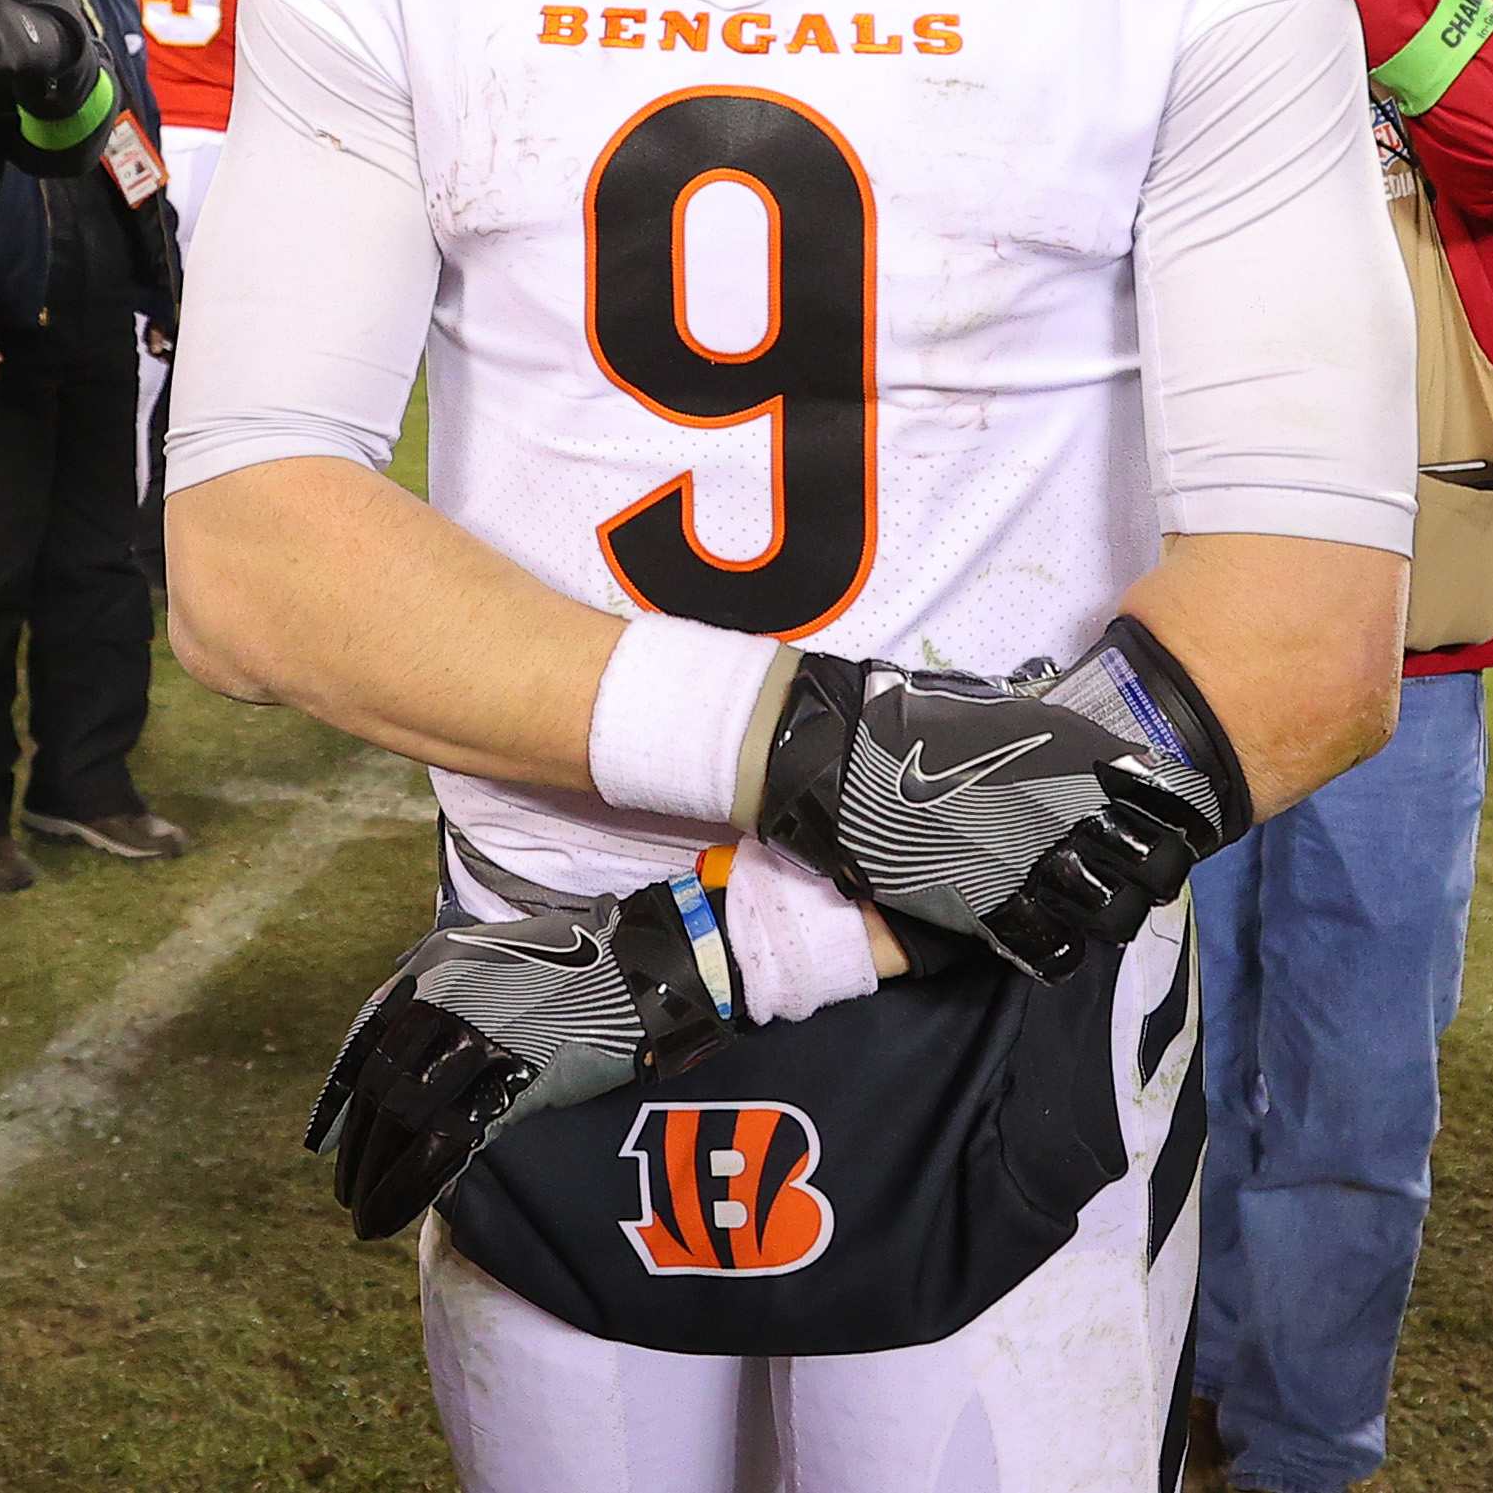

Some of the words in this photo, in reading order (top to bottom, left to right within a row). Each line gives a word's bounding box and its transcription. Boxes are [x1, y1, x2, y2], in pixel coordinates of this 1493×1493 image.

[537, 4, 963, 55] BENGALS
[1374, 124, 1403, 159] FL
[1384, 171, 1417, 200] EDIA
[583, 84, 878, 643] 9
[617, 1101, 836, 1278] B
